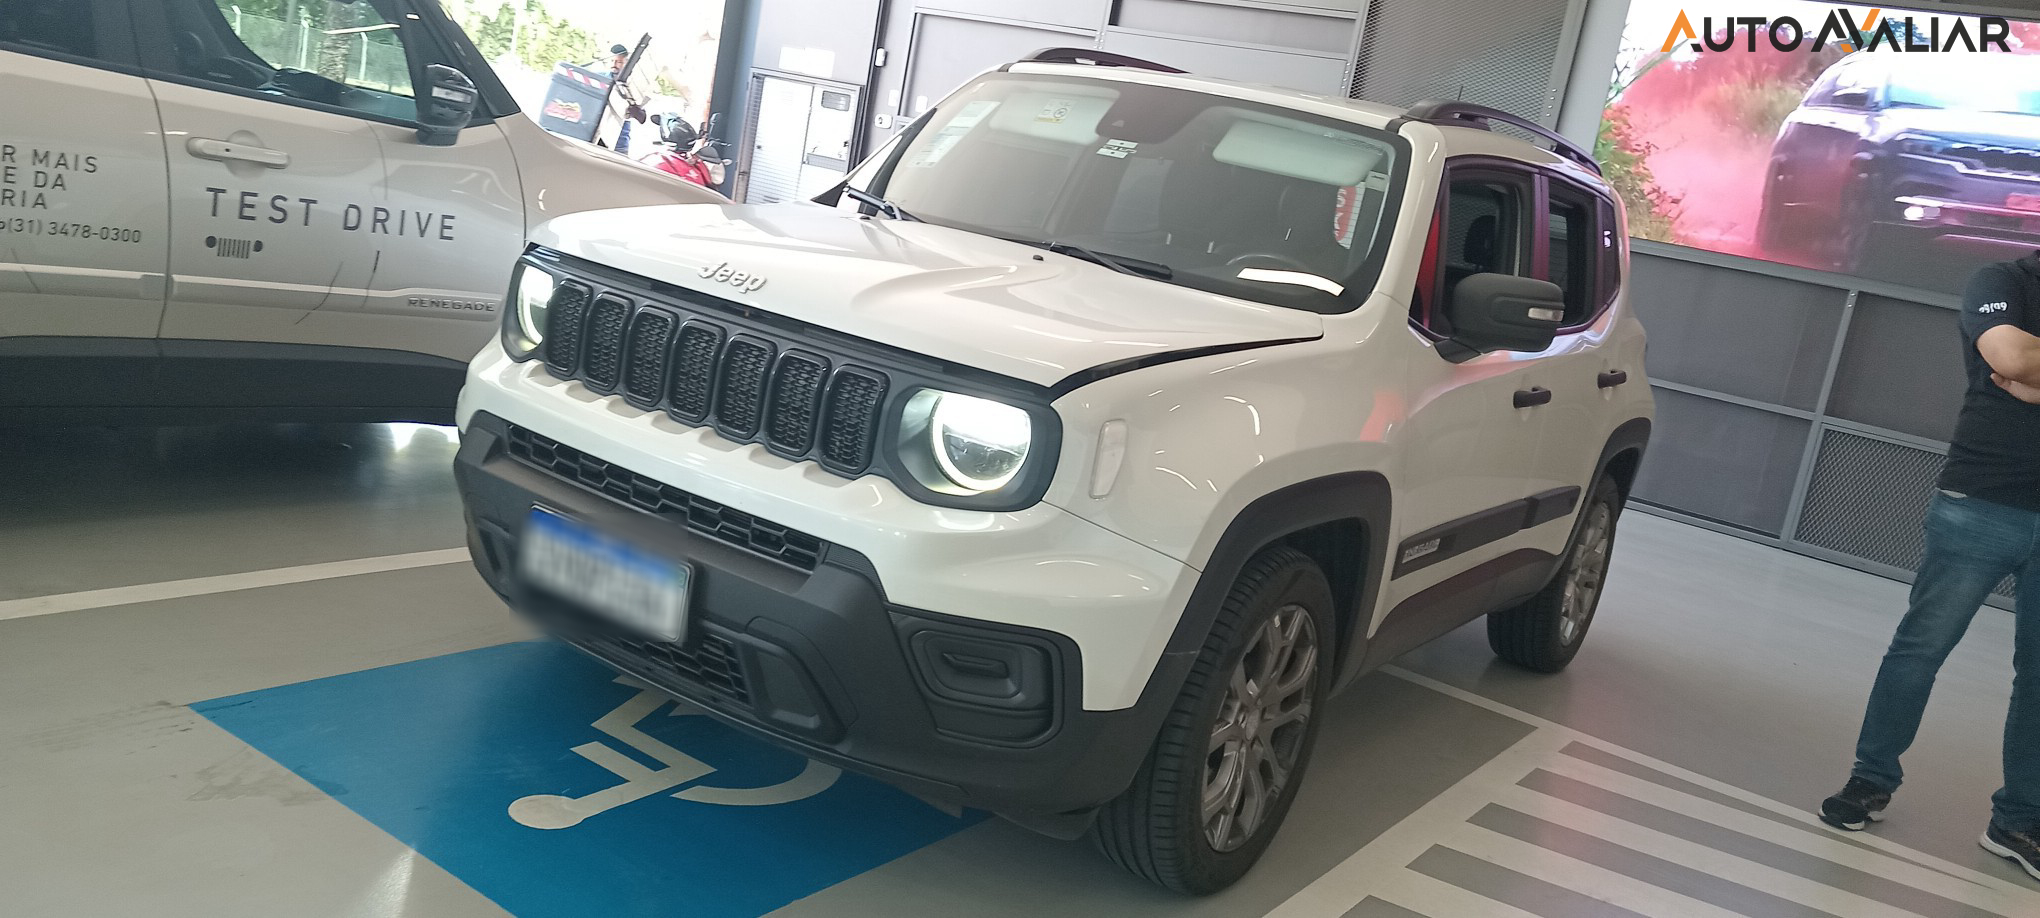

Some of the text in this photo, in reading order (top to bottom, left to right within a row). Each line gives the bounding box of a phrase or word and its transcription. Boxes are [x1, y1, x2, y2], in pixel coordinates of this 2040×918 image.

[31, 148, 98, 173] MAIS
[33, 170, 66, 191] DA
[206, 186, 456, 241] TEST DRIVE
[48, 221, 141, 243] 3478-0300
[697, 261, 768, 295] Jeep
[407, 296, 496, 312] RENEGADE
